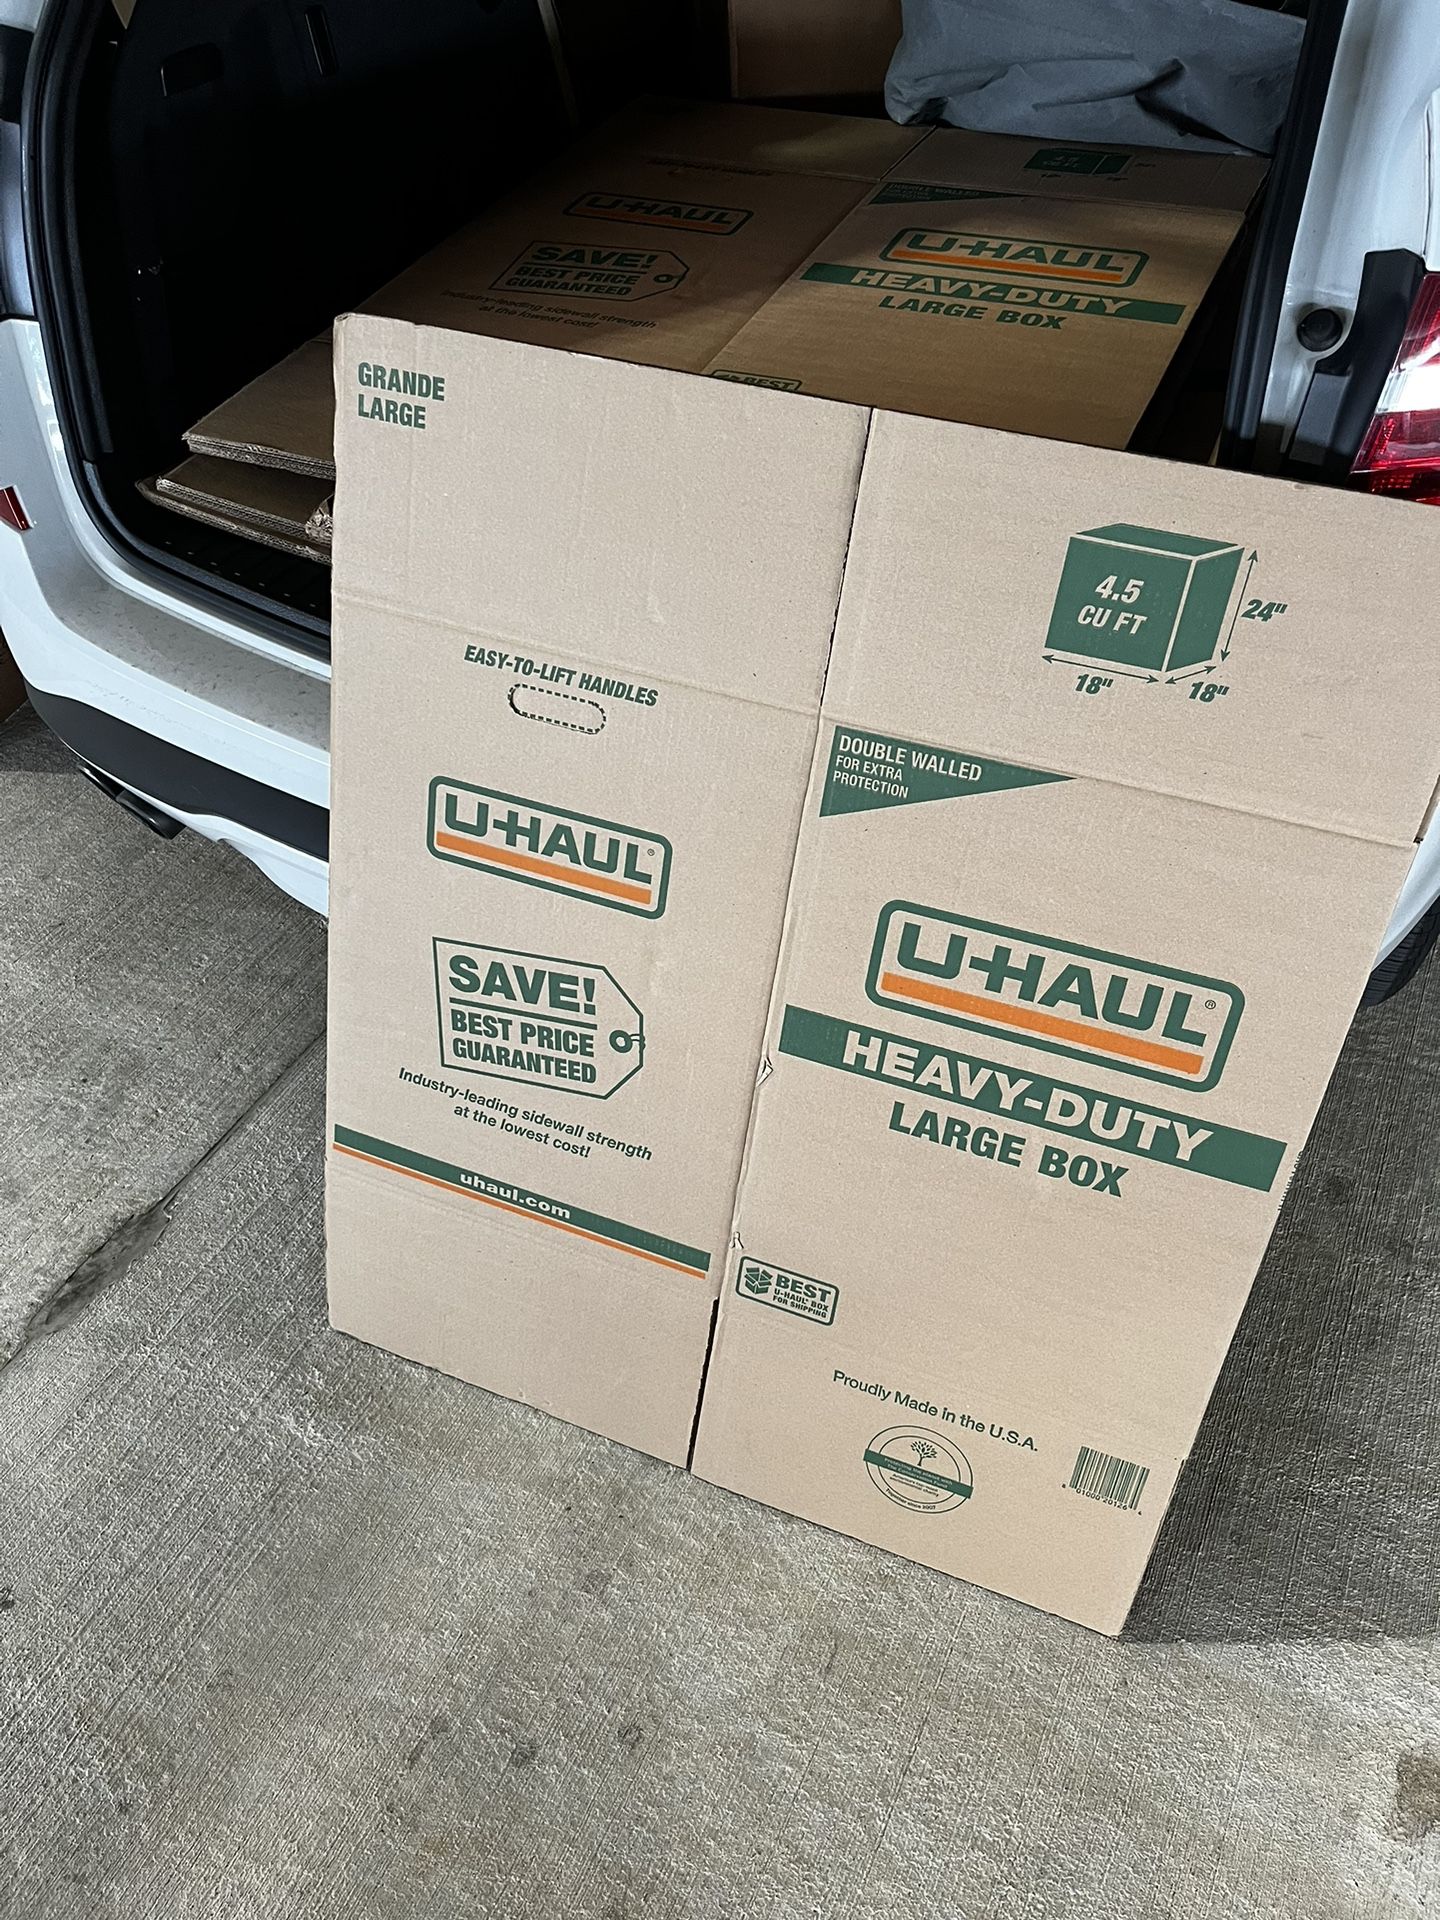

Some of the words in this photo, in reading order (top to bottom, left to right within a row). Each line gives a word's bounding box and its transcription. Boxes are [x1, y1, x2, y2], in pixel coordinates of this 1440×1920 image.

[585, 195, 739, 227] U-HAUL
[531, 246, 658, 269] SAVE!
[504, 277, 633, 297] GUARANTEED
[514, 266, 572, 280] BEST
[573, 270, 642, 285] PRICE
[851, 269, 1134, 314] HEAVY-DUTY
[494, 306, 517, 315] the
[518, 310, 562, 323] lowest
[544, 302, 600, 321] sidewall
[599, 314, 657, 330] strength
[878, 294, 988, 320] LARGE
[995, 308, 1068, 330] BOX
[357, 362, 445, 402] GRANDE
[357, 393, 427, 429] LARGE
[1094, 574, 1144, 604] 4.5
[1077, 604, 1109, 628] CU
[1112, 611, 1148, 636] FT
[1241, 598, 1288, 623] 24"
[463, 645, 577, 687] EASY-TO-LIFT
[578, 672, 659, 708] HANDLES
[1074, 673, 1113, 696] 18"
[1188, 681, 1230, 704] 18"
[836, 754, 860, 775] FOR
[862, 760, 904, 783] EXTRA
[838, 735, 909, 767] DOUBLE
[912, 750, 982, 783] WALLED
[832, 769, 909, 800] PROTECTION
[448, 954, 597, 1015] SAVE!
[450, 1008, 513, 1039] BEST
[520, 1023, 595, 1059] PRICE
[452, 1037, 598, 1085] GUARANTEED
[842, 1030, 1215, 1162] HEAVY-DUTY
[398, 1066, 519, 1119] Industry-leading
[520, 1107, 584, 1139] sidewall
[586, 1129, 653, 1161] strength
[453, 1104, 469, 1118] at
[471, 1109, 496, 1128] the
[499, 1117, 551, 1144] lowest
[553, 1135, 592, 1158] cost!
[888, 1101, 1026, 1167] LARGE
[1037, 1146, 1129, 1199] BOX
[459, 1172, 572, 1220] uhaul.com
[775, 1274, 832, 1303] BEST
[772, 1295, 789, 1306] FOR
[790, 1301, 827, 1318] SHIPPING
[811, 1300, 830, 1313] BOX
[832, 1369, 892, 1403] Proudly
[894, 1390, 939, 1418] Made
[941, 1405, 956, 1424] in
[959, 1412, 987, 1434] the
[989, 1423, 1039, 1451] U.S.A.
[1075, 1488, 1101, 1501] 01000
[1102, 1498, 1128, 1511] 20126
